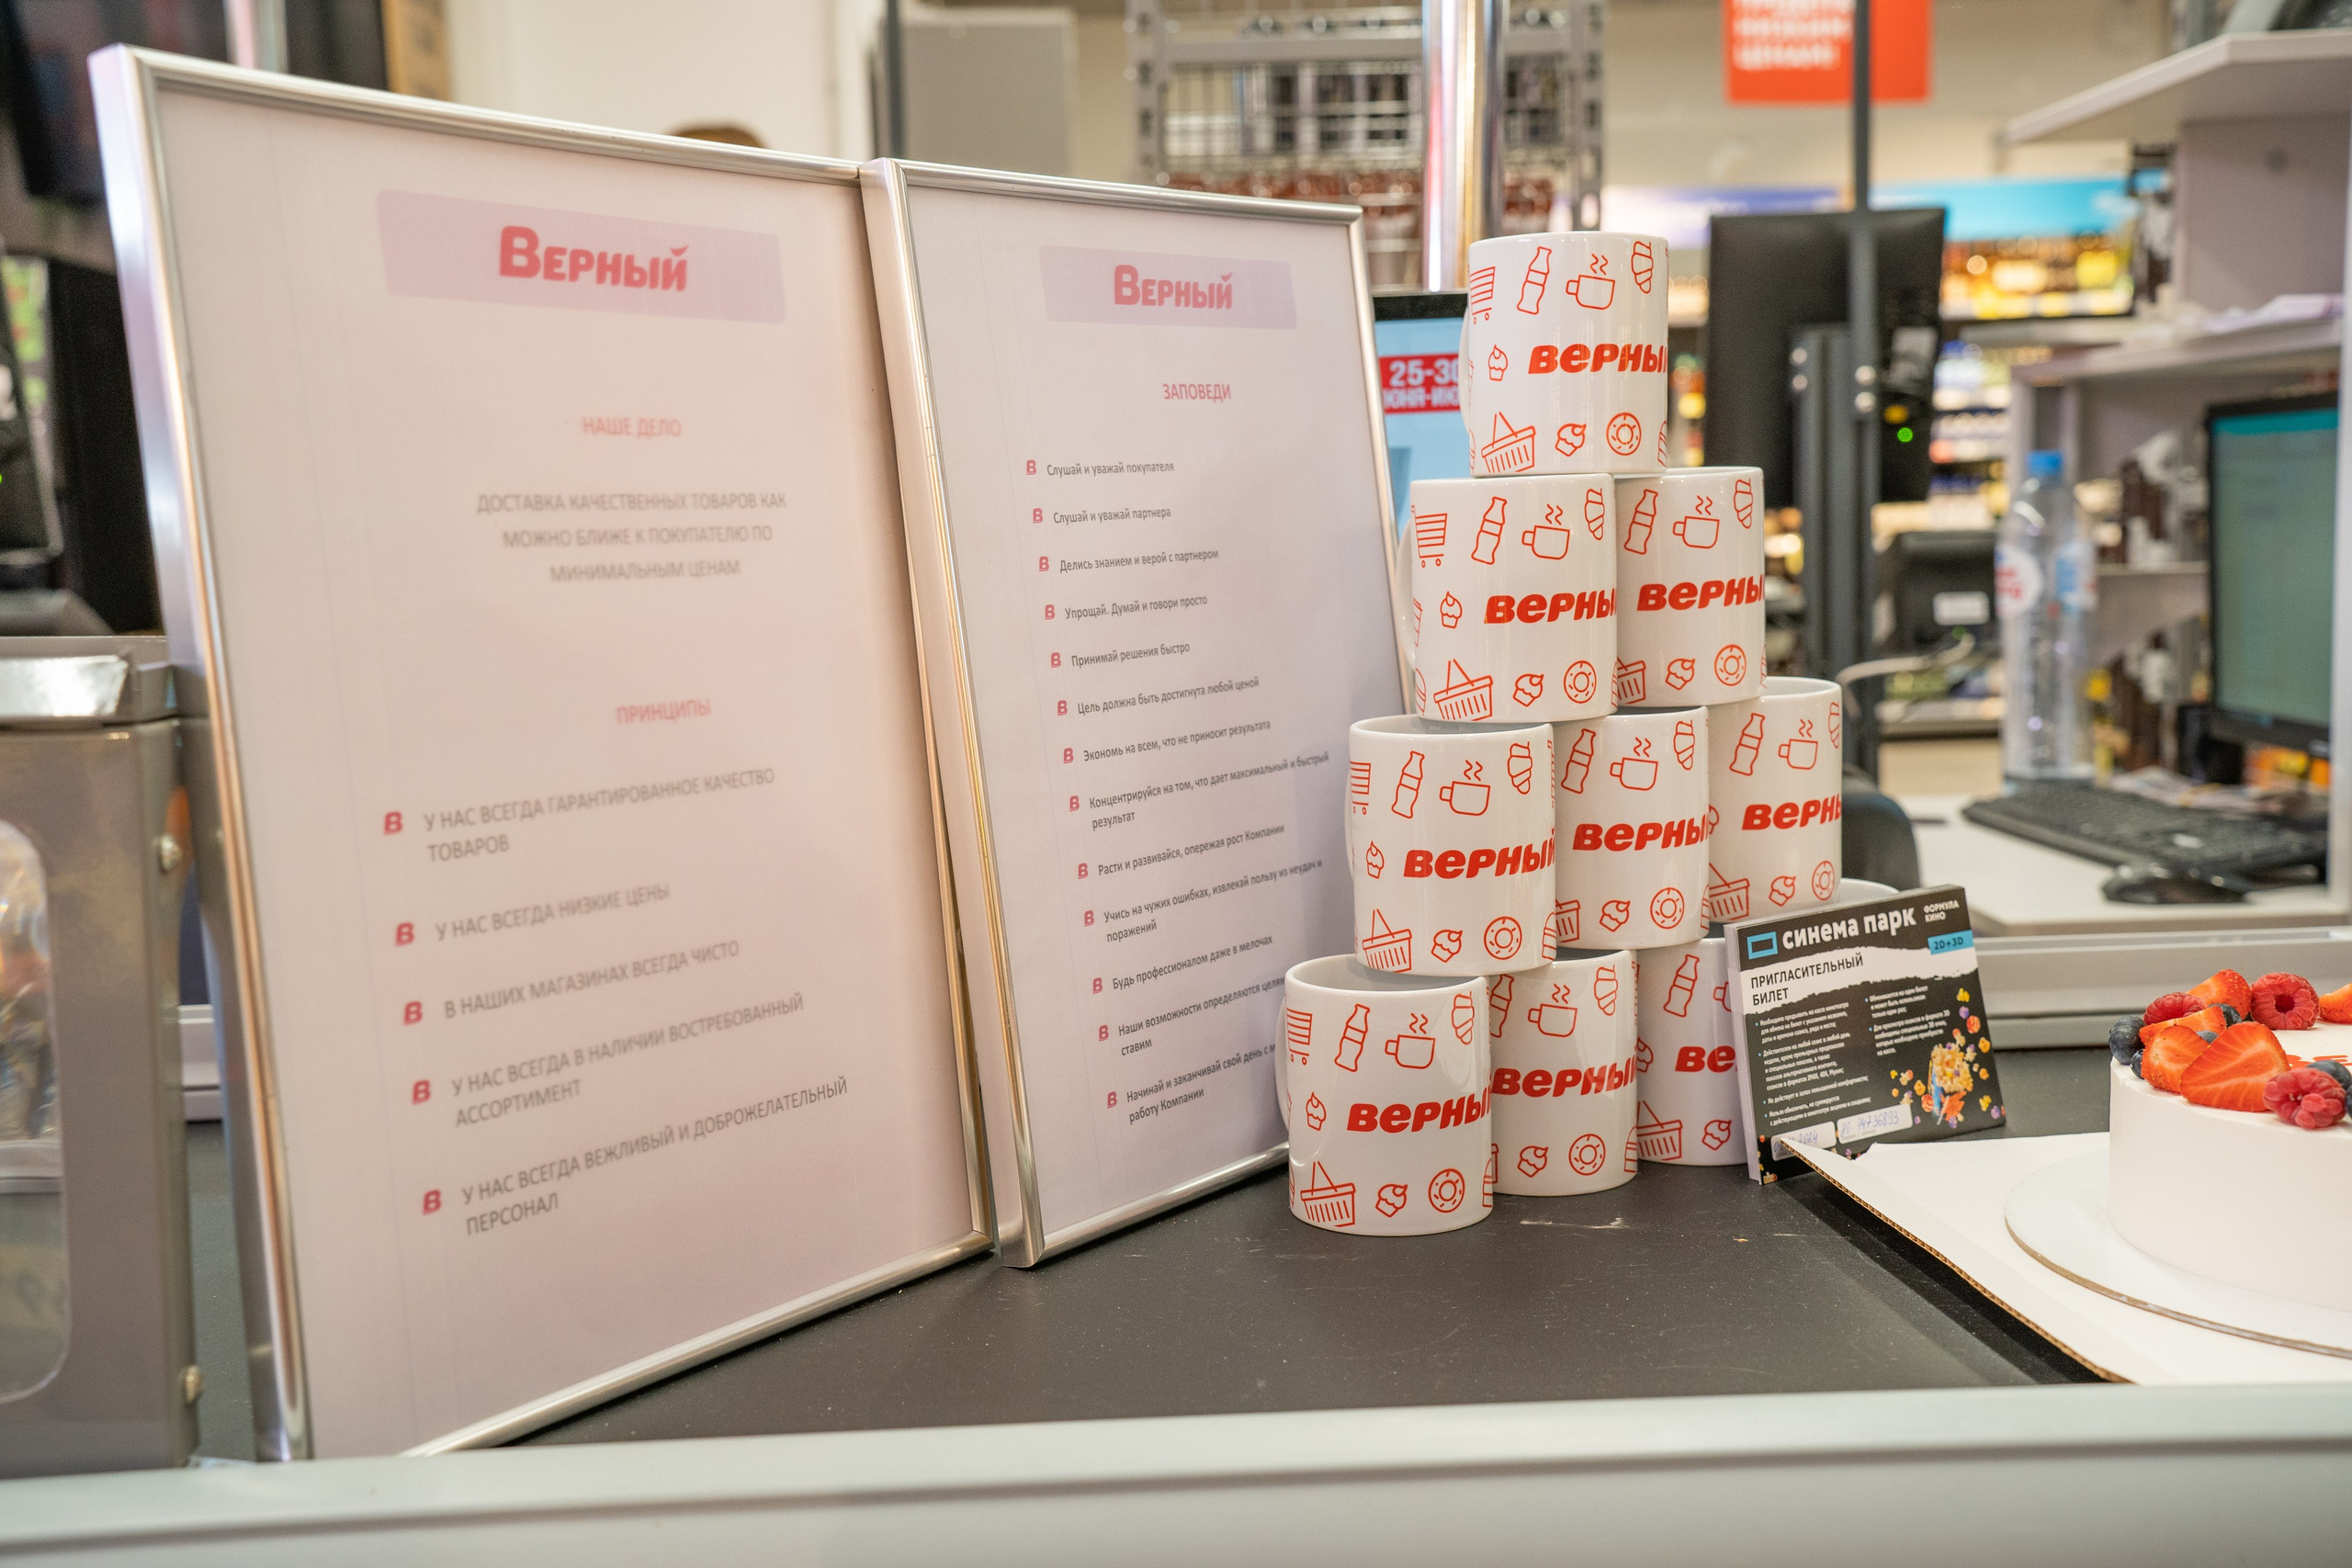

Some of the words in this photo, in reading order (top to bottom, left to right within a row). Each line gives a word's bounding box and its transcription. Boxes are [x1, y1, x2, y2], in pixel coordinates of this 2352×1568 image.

[1528, 343, 1668, 375] верны
[1162, 383, 1232, 403] ЗАПОВЕДИ
[581, 417, 632, 436] НАШЕ
[636, 417, 682, 438] ДЕЛО
[1046, 463, 1082, 479] Слушай
[1091, 461, 1125, 477] уважай
[1125, 463, 1174, 475] покупателя
[476, 493, 566, 515] ДОСТАВКА
[569, 493, 688, 511] КАЧЕСТВЕННЫХ
[690, 492, 758, 510] ТОВАРОВ
[760, 493, 787, 508] КАК
[1053, 510, 1089, 525] Слушай
[1097, 508, 1131, 524] уважай
[1132, 508, 1171, 521] партнера
[502, 529, 572, 548] МОЖНО
[575, 527, 632, 547] БЛИЖЕ
[648, 525, 750, 545] ПОКУПАТЕЛЮ
[752, 525, 773, 541] ПО
[549, 561, 685, 582] МИНИМАЛЬНЫМ
[688, 559, 741, 579] ЦЕНАМ
[1059, 559, 1093, 574] Делись
[1094, 557, 1133, 569] знанием
[1141, 551, 1168, 566] верой
[1174, 550, 1219, 563] партнером
[1064, 604, 1110, 621] Упрощай.
[1111, 600, 1140, 616] Думай
[1149, 599, 1179, 611] говори
[1180, 596, 1208, 608] просто
[1637, 574, 1765, 612] верны
[1071, 649, 1119, 669] Принимай
[1120, 648, 1159, 662] решения
[1159, 643, 1191, 655] быстро
[616, 699, 711, 725] ПРИНЦИПЫ
[1077, 703, 1101, 716] Цель
[1102, 697, 1136, 713] должна
[1137, 693, 1159, 705] быть
[1160, 686, 1205, 704] достигнута
[1207, 680, 1234, 694] любой
[1235, 676, 1260, 692] ценой
[1083, 747, 1124, 761] Экономь
[1125, 744, 1136, 754] на
[1136, 740, 1161, 752] всем,
[1161, 737, 1177, 747] что
[1177, 735, 1189, 745] не
[1190, 728, 1227, 744] приносит
[1228, 721, 1271, 738] результата
[1089, 785, 1162, 809] Концентрируйся
[1162, 784, 1174, 794] на
[1174, 781, 1194, 791] том,
[1194, 777, 1209, 787] что
[1210, 773, 1228, 787] дает
[1229, 759, 1288, 781] максимальный
[1295, 751, 1329, 767] быстрый
[439, 807, 477, 829] НАС
[479, 798, 545, 824] ВСЕГДА
[547, 777, 700, 813] ГАРАНТИРОВАННОЕ
[703, 768, 775, 791] КАЧЕСТВО
[1091, 812, 1136, 831] результат
[426, 834, 510, 862] ТОВАРОВ
[1098, 862, 1124, 875] Расти
[1132, 848, 1183, 870] развивайся,
[1184, 839, 1226, 855] опережая
[1226, 834, 1244, 848] рост
[1245, 825, 1284, 840] Компании
[1103, 909, 1131, 923] Учись
[1131, 905, 1143, 916] на
[1144, 898, 1171, 914] чужих
[1171, 888, 1212, 905] ошибках,
[1212, 874, 1250, 895] извлекай
[1250, 871, 1277, 885] пользу
[1278, 868, 1288, 877] из
[1289, 862, 1316, 874] неудач
[1923, 899, 1960, 914] ФОРМУЛА
[451, 915, 488, 938] НАС
[491, 904, 556, 931] ВСЕГДА
[558, 890, 622, 917] НИЗКИЕ
[626, 884, 670, 907] ЦЕНЫ
[1925, 911, 1946, 923] КИНО
[1106, 919, 1158, 942] поражений
[1782, 919, 1860, 950] синема
[1863, 907, 1917, 936] парк
[1933, 937, 1963, 951] 2D+3D
[459, 986, 526, 1015] НАШИХ
[528, 964, 629, 999] МАГАЗИНАХ
[631, 952, 689, 978] ВСЕГДА
[691, 940, 740, 964] ЧИСТО
[1112, 976, 1135, 990] Будь
[1136, 954, 1209, 984] профессионалом
[1209, 947, 1231, 963] даже
[1238, 936, 1272, 952] мелочах
[1750, 953, 1864, 989] ПРИГЛАСИТЕЛЬНЫЙ
[1118, 1021, 1144, 1036] Наши
[1145, 1003, 1202, 1028] возможности
[1203, 984, 1261, 1010] определяются
[1261, 976, 1285, 992] целям
[1752, 987, 1789, 1006] БИЛЕТ
[467, 1067, 503, 1092] НАС
[506, 1052, 571, 1083] ВСЕГДА
[588, 1029, 665, 1062] НАЛИЧИИ
[668, 991, 804, 1043] ВОСТРЕБОВАННЫЙ
[1121, 1038, 1153, 1056] ставим
[1126, 1079, 1165, 1103] Начинай
[1173, 1059, 1222, 1087] заканчивай
[1222, 1053, 1242, 1069] свой
[1243, 1049, 1263, 1065] день
[456, 1078, 581, 1127] АССОРТИМЕНТ
[1129, 1104, 1159, 1125] работу
[1159, 1089, 1204, 1111] Компании
[478, 1174, 514, 1200] НАС
[517, 1156, 582, 1189] ВСЕГДА
[583, 1124, 675, 1169] ВЕЖЛИВЫЙ
[693, 1075, 847, 1141] ДОБРОЖЕЛАТЕЛЬНЫЙ
[466, 1192, 559, 1235] ПЕРСОНАЛ
